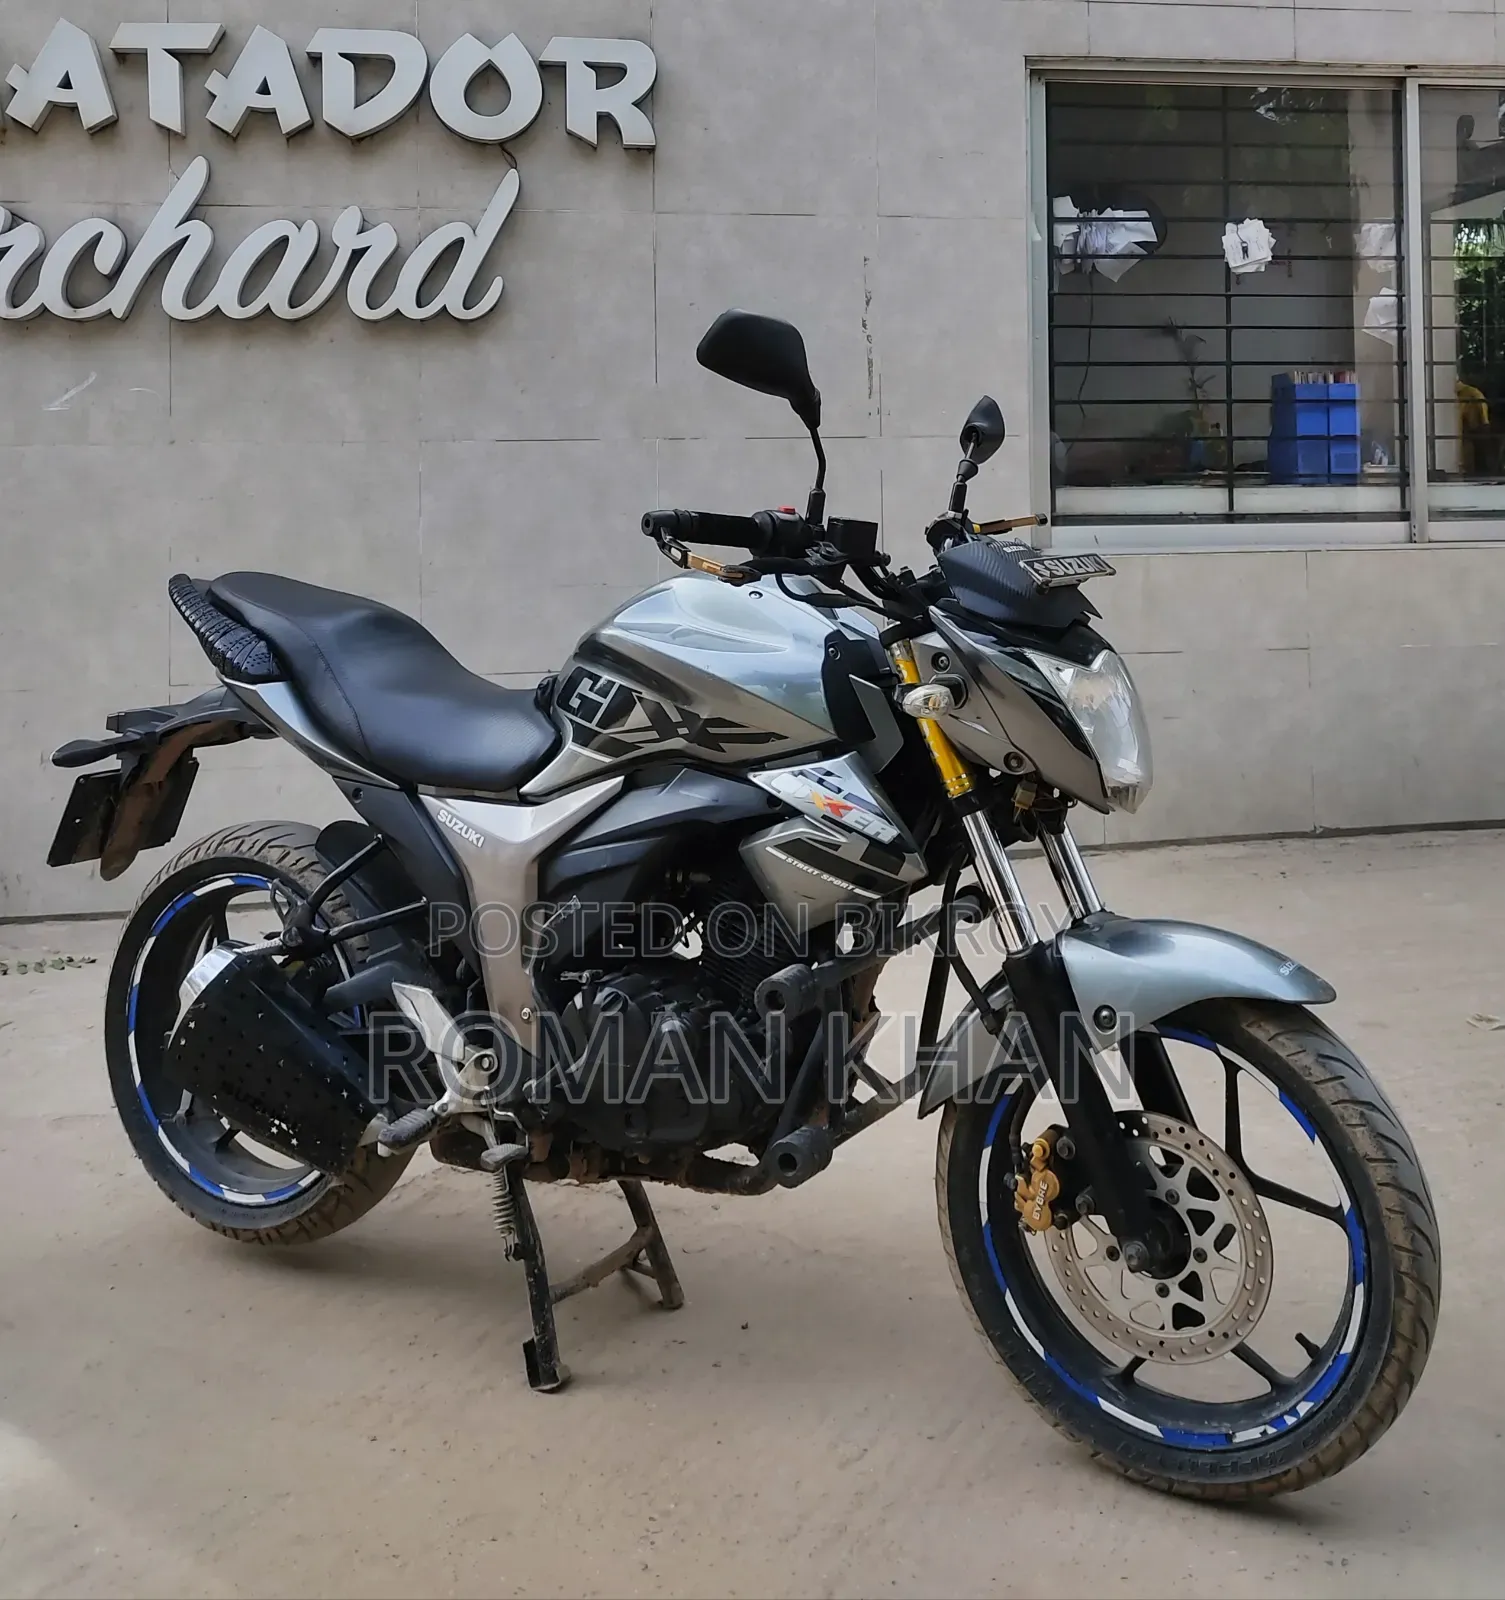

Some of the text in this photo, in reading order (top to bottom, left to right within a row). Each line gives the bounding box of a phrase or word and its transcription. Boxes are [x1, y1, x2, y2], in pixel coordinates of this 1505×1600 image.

[5, 17, 656, 148] ATADOR
[1044, 556, 1107, 576] SUZUKI
[437, 808, 485, 848] SUZUKI
[785, 857, 856, 891] STREET SPORT
[1031, 1180, 1048, 1221] BYBRE
